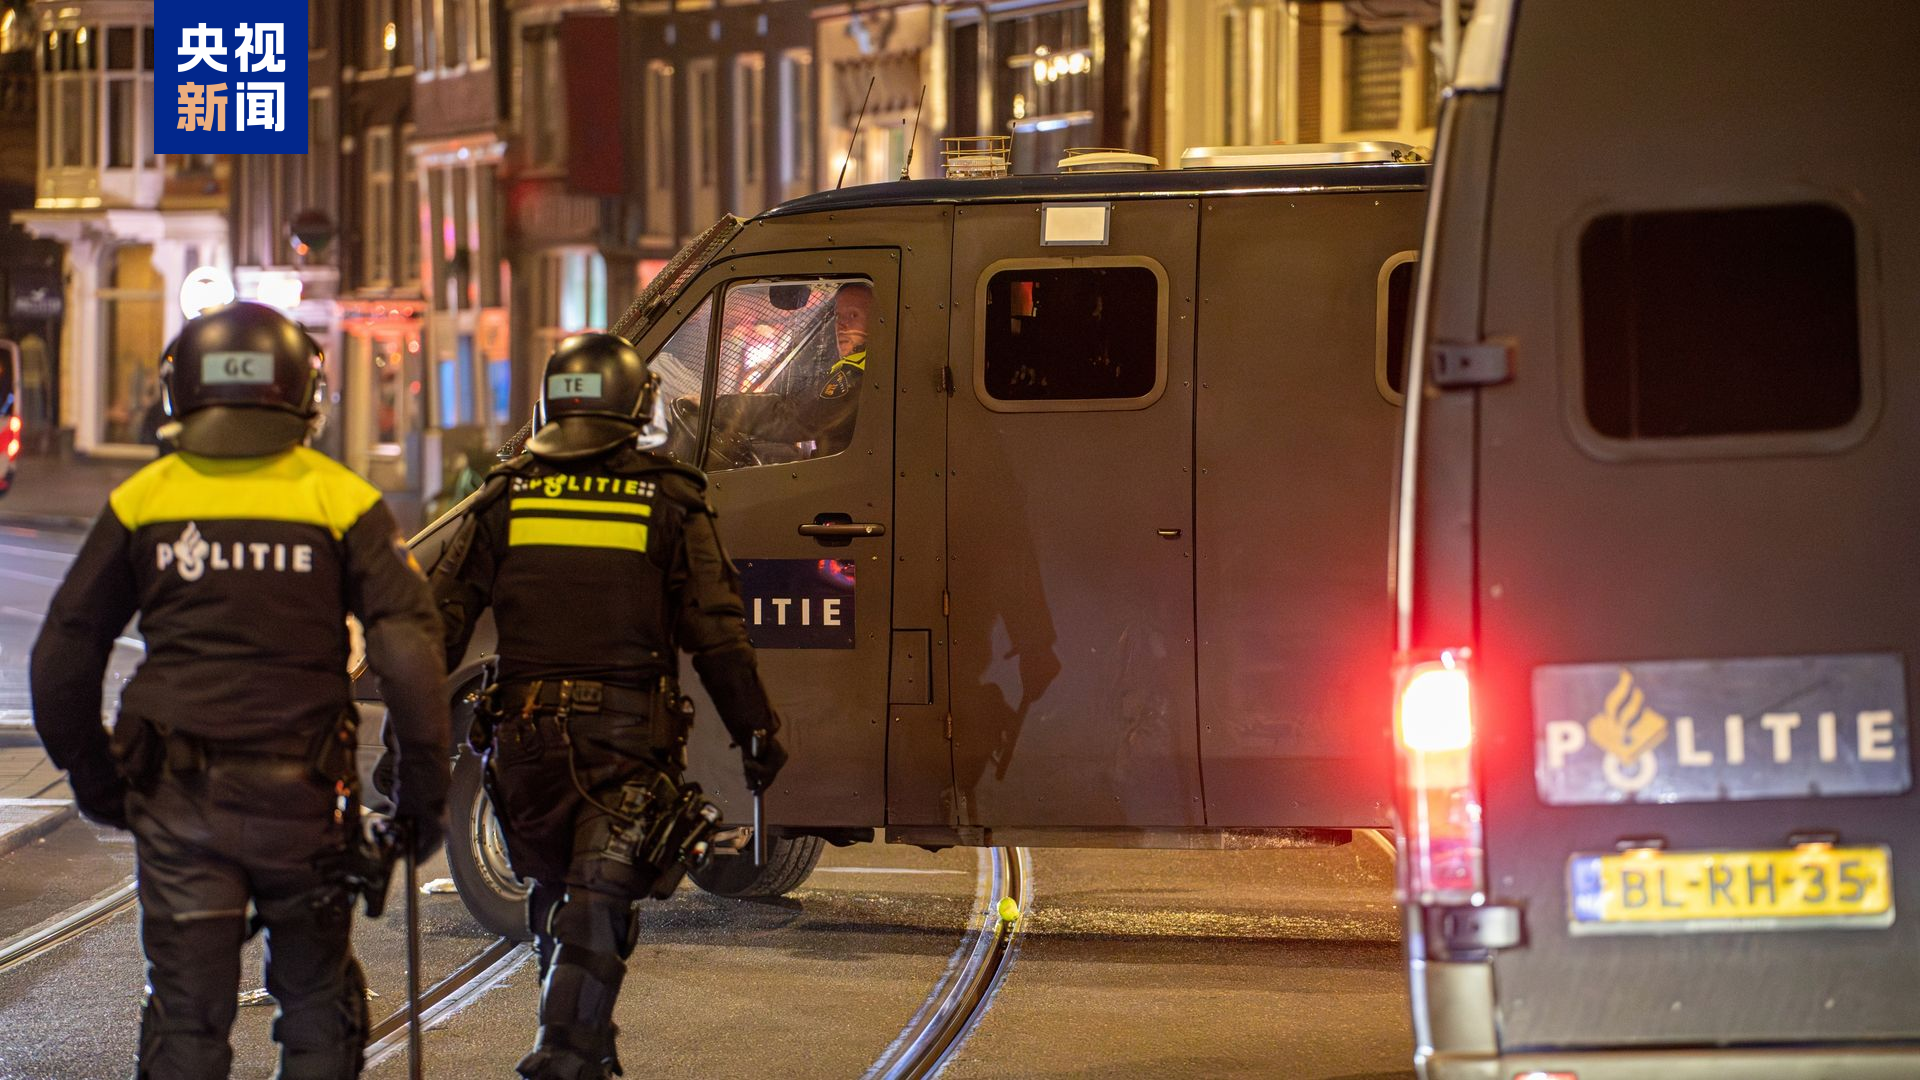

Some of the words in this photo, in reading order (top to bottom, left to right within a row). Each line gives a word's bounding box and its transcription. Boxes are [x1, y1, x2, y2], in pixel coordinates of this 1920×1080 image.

[224, 357, 255, 378] GC
[564, 377, 583, 393] TE
[156, 540, 313, 582] POLITIE
[753, 597, 841, 626] ITIE
[1545, 709, 1897, 792] POLITIE
[1620, 860, 1867, 909] BL-RH-35
